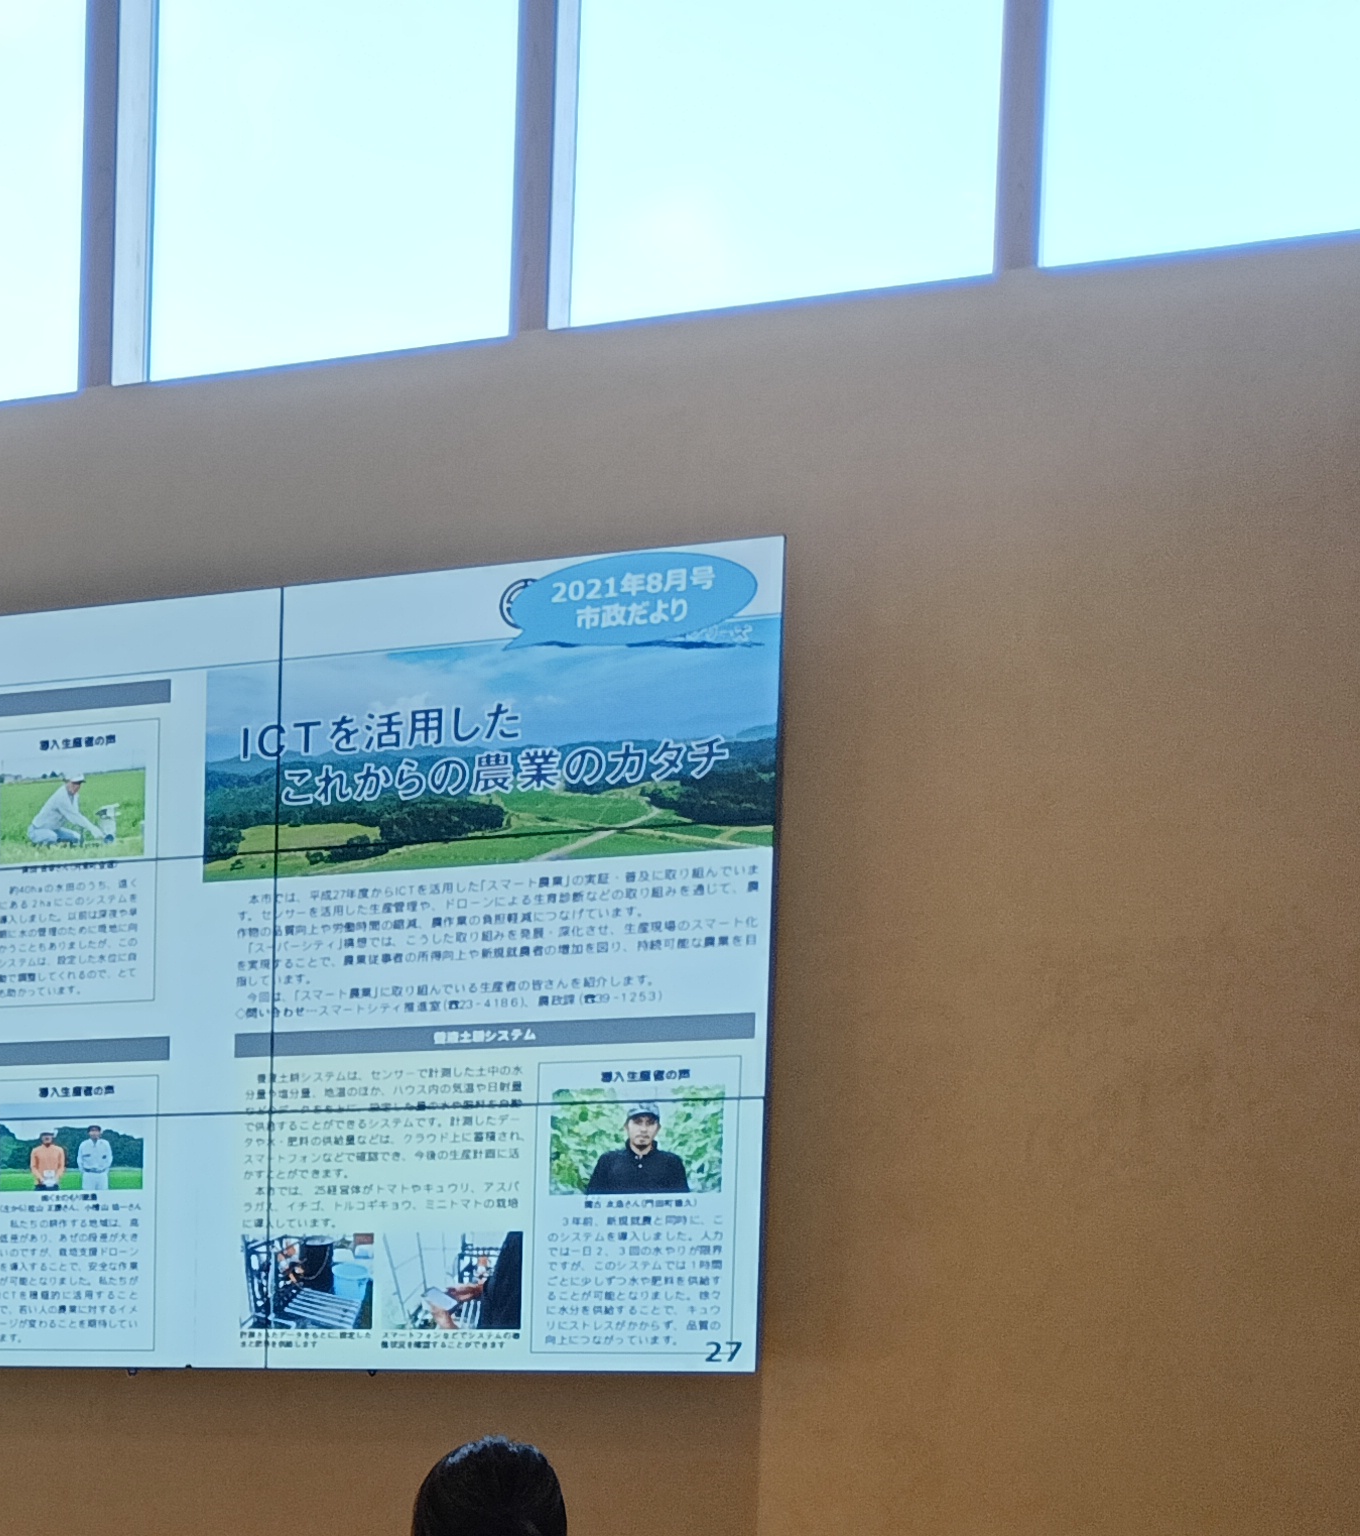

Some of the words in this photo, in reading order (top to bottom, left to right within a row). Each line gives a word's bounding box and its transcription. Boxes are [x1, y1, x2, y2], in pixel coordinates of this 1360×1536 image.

[551, 565, 716, 603] 2021年8月号
[576, 598, 688, 630] 市政だより
[240, 702, 522, 763] ICTを活用した
[280, 734, 730, 807] これからの農業のカタチ
[704, 1341, 743, 1363] 27
